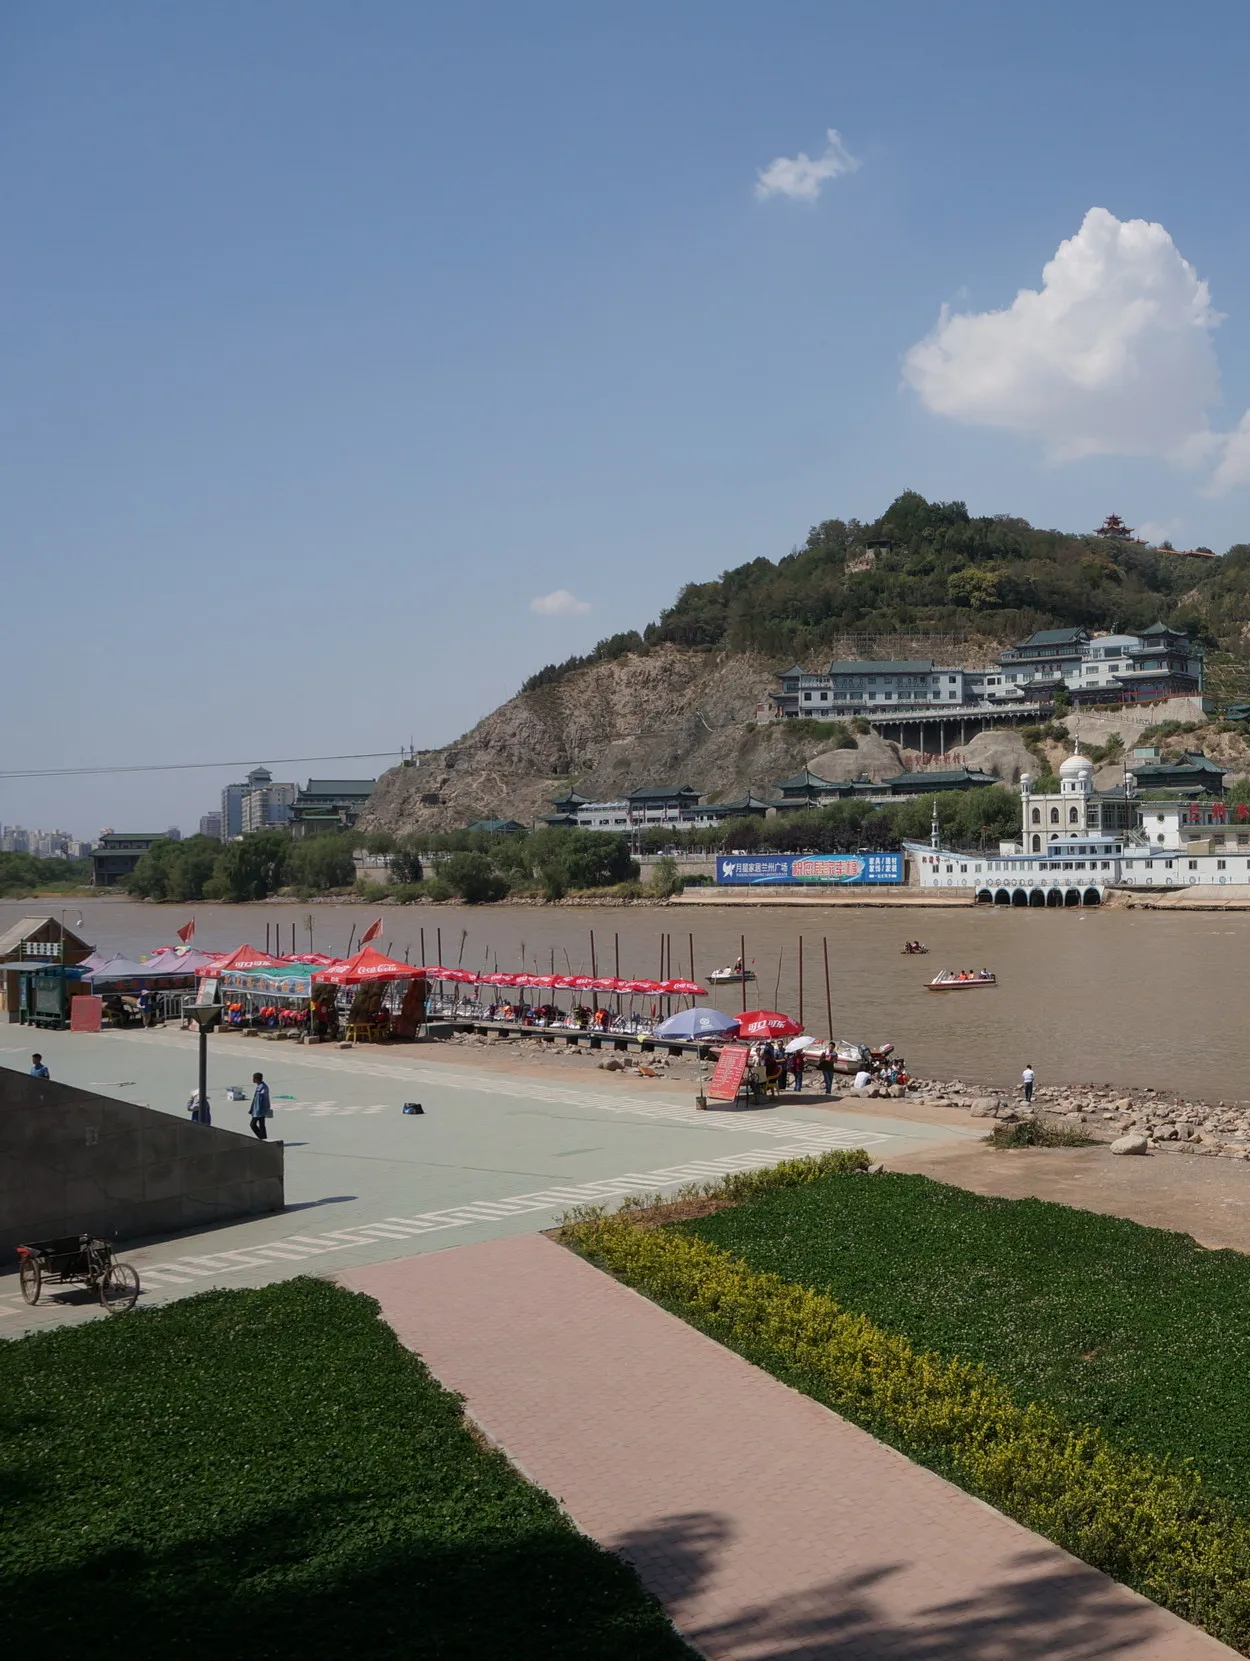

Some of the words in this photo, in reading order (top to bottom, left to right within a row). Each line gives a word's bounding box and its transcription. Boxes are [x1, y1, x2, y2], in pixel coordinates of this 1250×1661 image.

[357, 963, 397, 974] Coca-Cola
[748, 1019, 786, 1033] 可口可乐
